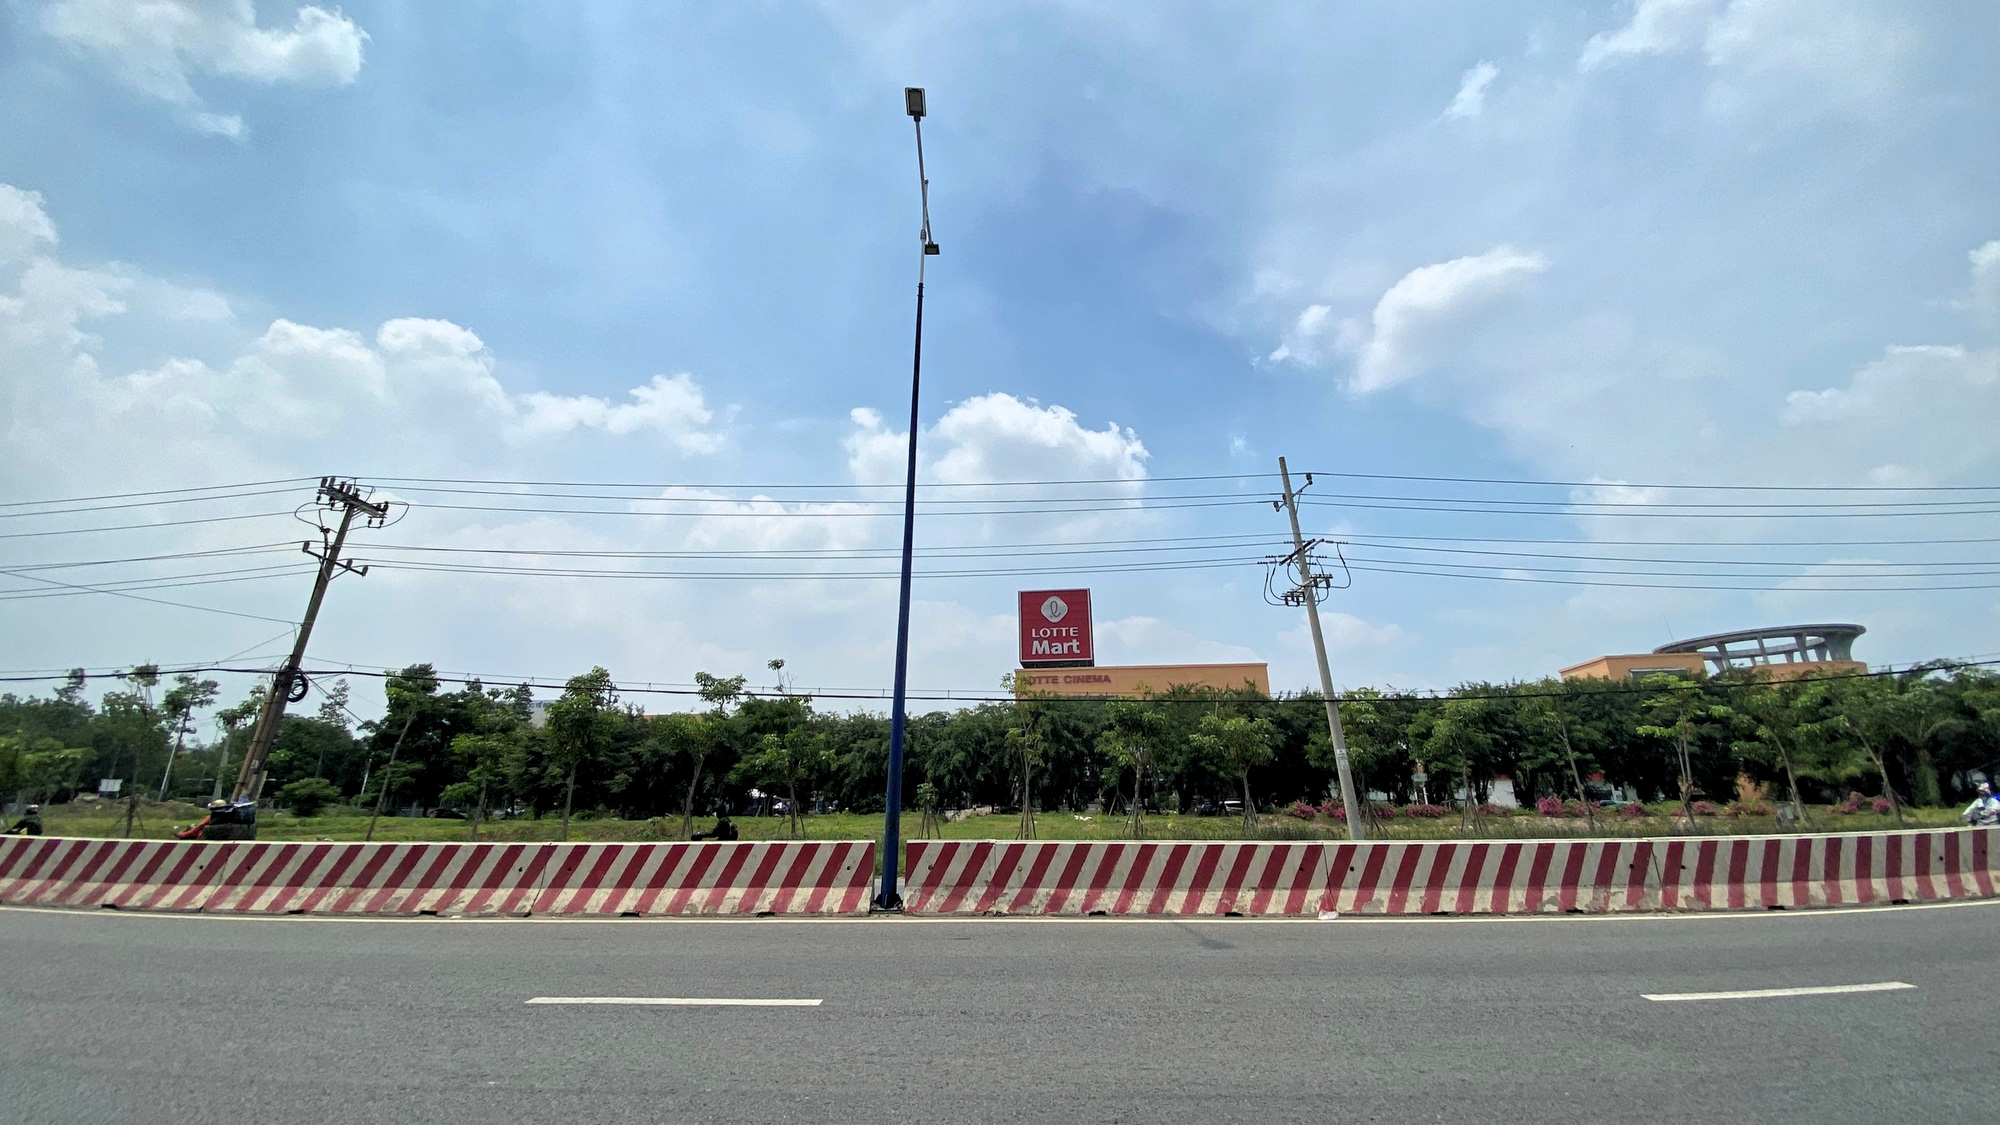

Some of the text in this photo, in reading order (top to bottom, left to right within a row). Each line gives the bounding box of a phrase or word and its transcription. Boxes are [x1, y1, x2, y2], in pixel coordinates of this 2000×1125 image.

[1032, 627, 1079, 638] LOTTE
[1031, 639, 1080, 655] Mart
[1026, 674, 1112, 685] OTTE CINEMA
